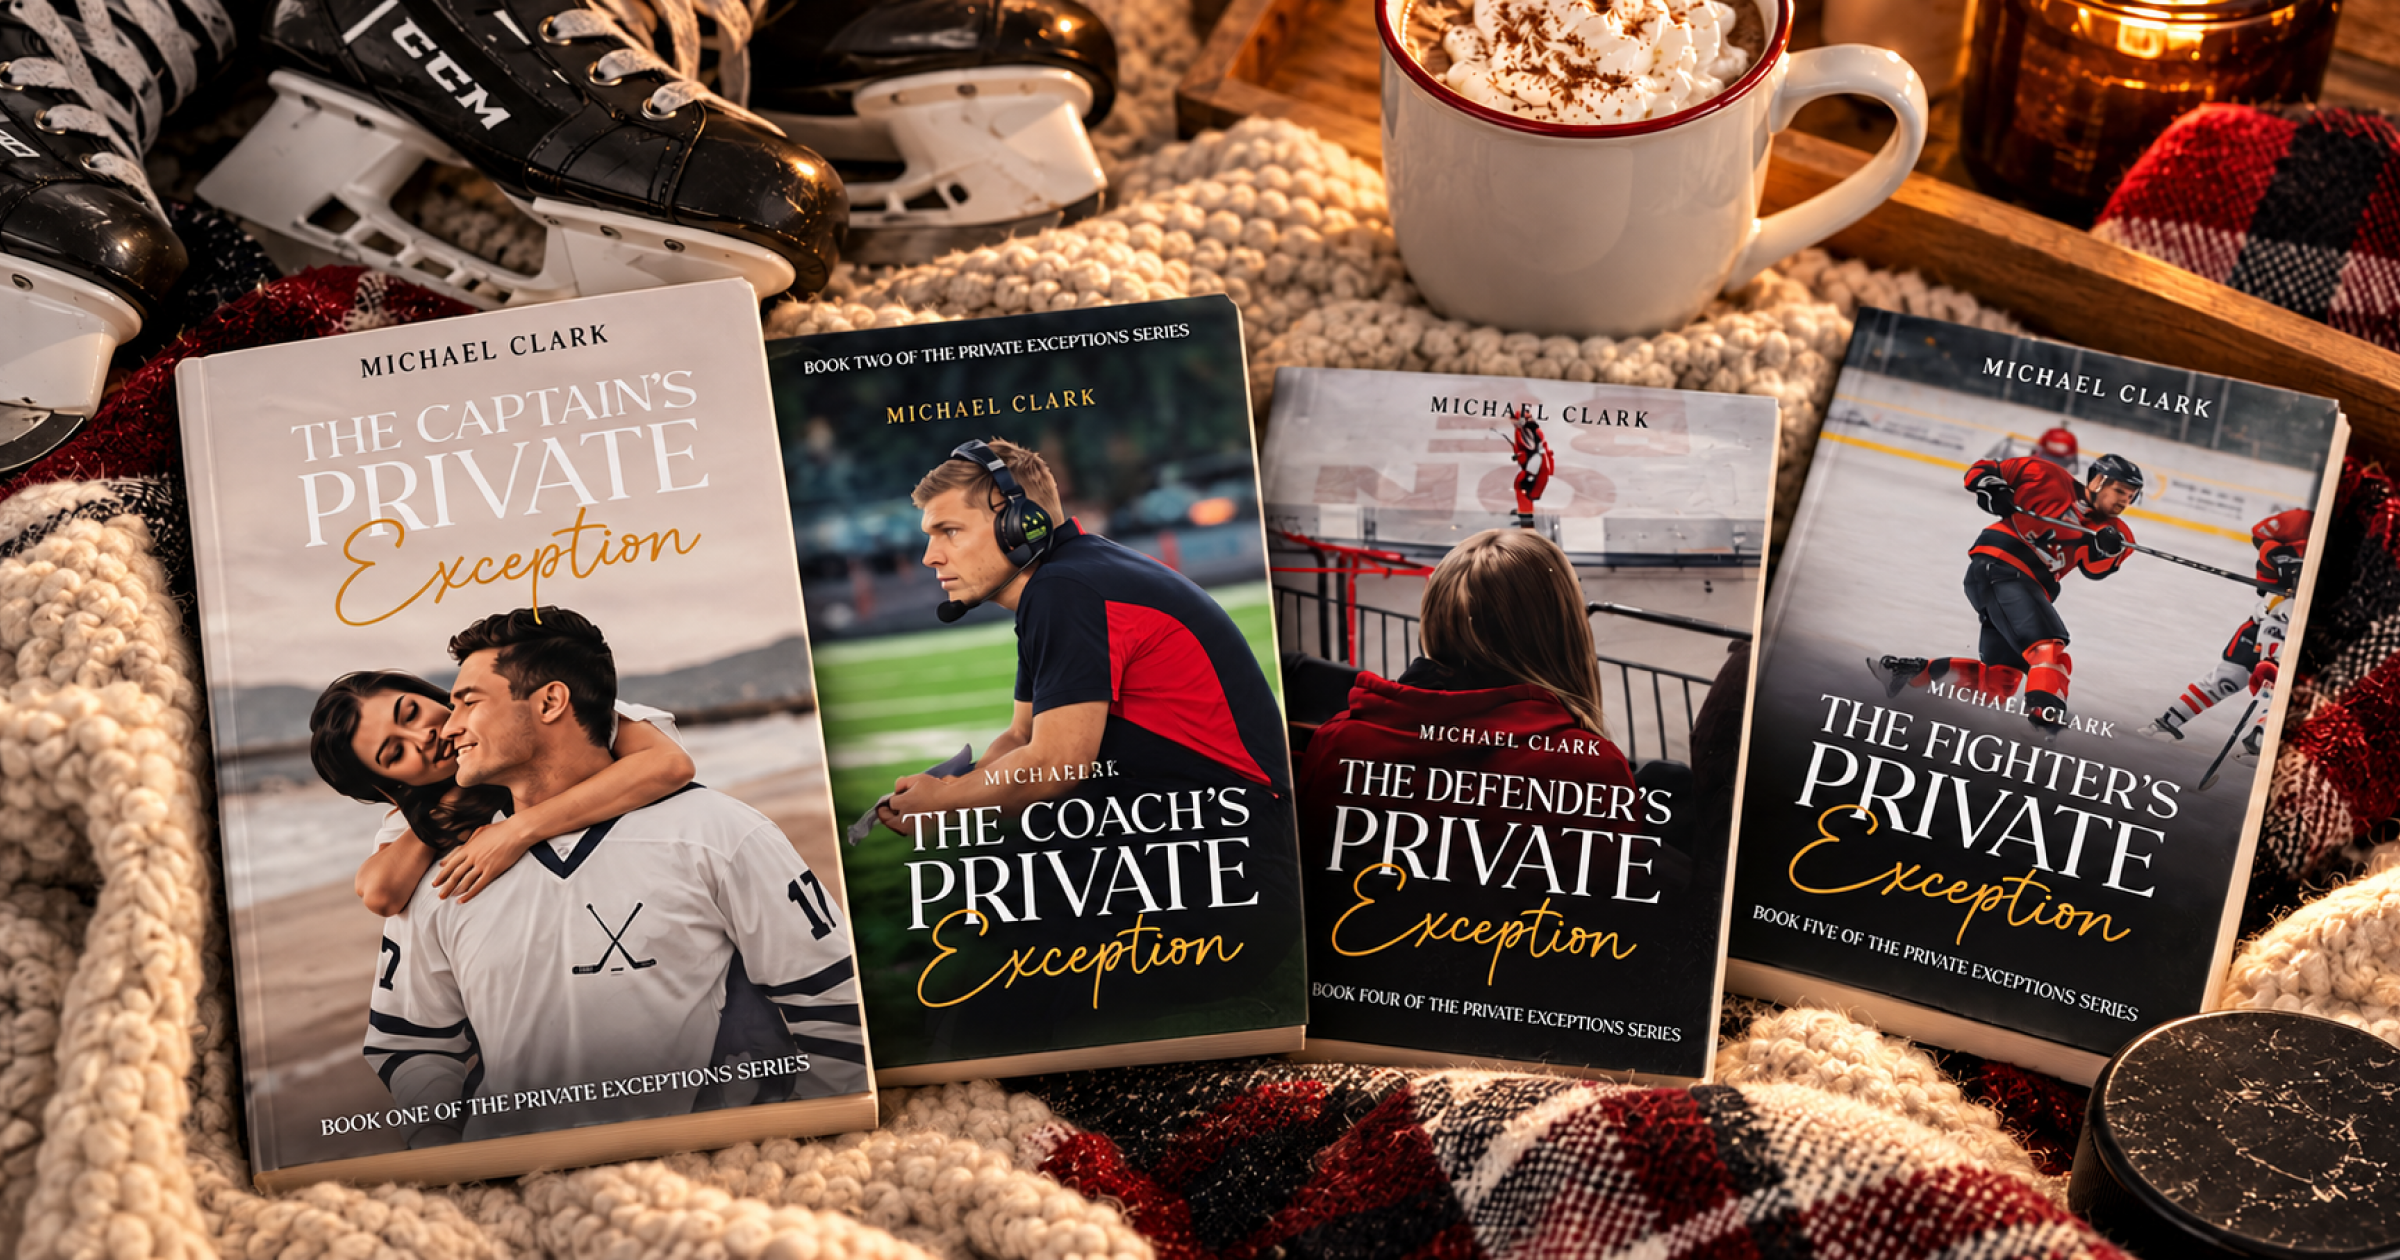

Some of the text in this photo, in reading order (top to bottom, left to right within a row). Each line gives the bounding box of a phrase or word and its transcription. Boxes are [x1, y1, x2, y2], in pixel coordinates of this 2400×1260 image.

[392, 16, 511, 130] CCM
[361, 324, 609, 378] MICHAEL CLARK
[804, 323, 1190, 375] BOOK TWO OF THE PRIVATE EXCEPTIONS SERIES
[1982, 357, 2213, 419] MICHAEL CLARK
[291, 370, 697, 462] THE CAPTAIN'S
[886, 388, 1097, 425] MICHAEL CLARK
[1431, 396, 1649, 428] MICHAEL CLARK
[298, 418, 709, 547] PRIVATE
[335, 507, 701, 627] Exception
[1419, 724, 1600, 757] MICHAEL CLARK
[1927, 680, 2115, 738] MICHAEL CLARK
[1339, 758, 1673, 825] THE DEFENDER'S
[1819, 694, 2181, 819] THE FIGHTER'S
[902, 787, 1250, 851] THE COACH'S
[1326, 805, 1662, 904] PRIVATE
[1795, 741, 2166, 898] PRIVATE
[788, 869, 836, 941] 17
[904, 836, 1259, 930] PRIVATE
[1788, 803, 2131, 945] Exception
[917, 908, 1244, 1009] Exception
[1331, 862, 1637, 986] Exception
[1753, 905, 2139, 1023] BOOK FIVE OF THE PRIVATE EXCEPTIONS SERIES
[1312, 982, 1682, 1042] BOOK FOUR OF THE PRIVATE EXCEPTIONS SERIES
[321, 1055, 811, 1137] BOOK ONE OF THE PRIVATE EXCEPTIONS SERIES
